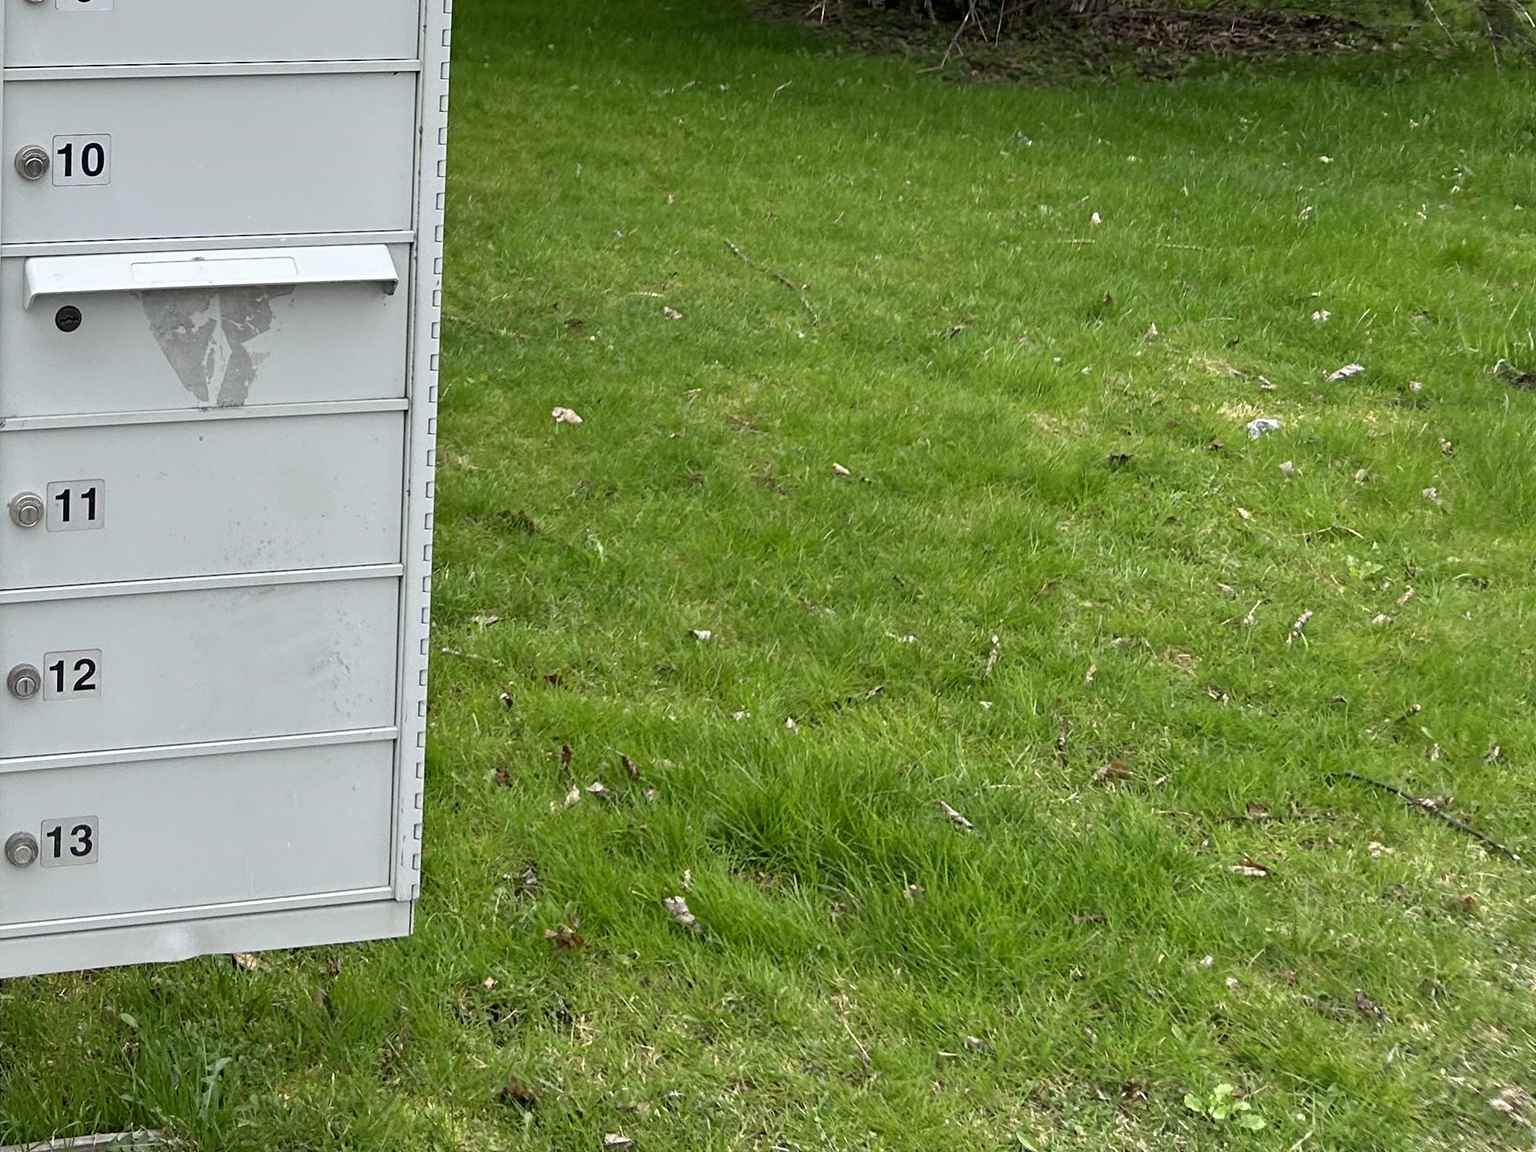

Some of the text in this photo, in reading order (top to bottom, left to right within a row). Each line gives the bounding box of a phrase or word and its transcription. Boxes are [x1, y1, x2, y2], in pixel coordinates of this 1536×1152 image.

[57, 142, 105, 178] 10
[54, 487, 98, 523] 11
[48, 658, 97, 693] 12
[46, 824, 94, 859] 13
